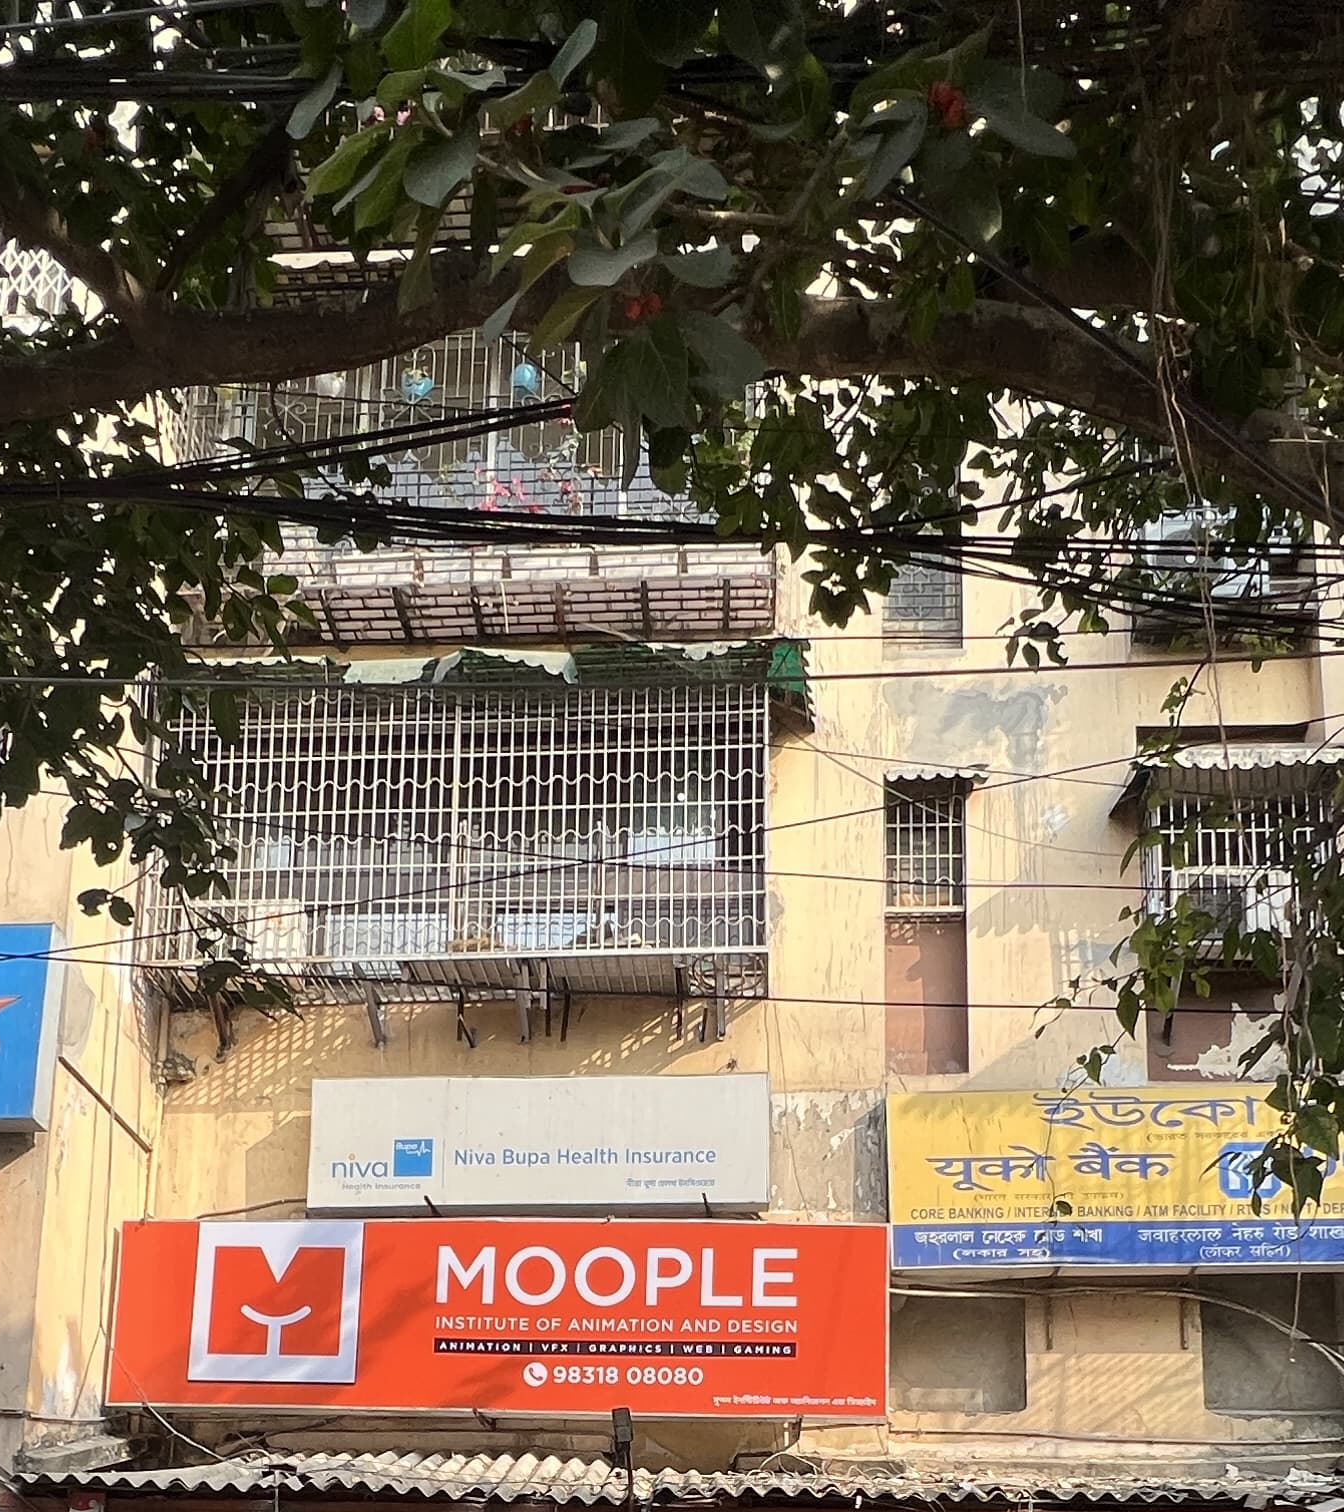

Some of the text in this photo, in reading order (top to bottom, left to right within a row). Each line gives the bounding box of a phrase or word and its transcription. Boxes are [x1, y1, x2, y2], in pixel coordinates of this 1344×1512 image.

[331, 1153, 388, 1178] niva
[454, 1148, 717, 1168] Niva Bupa Health Insurance
[926, 1142, 1176, 1191] यूको बैंक
[911, 1208, 945, 1219] CORE
[949, 1207, 1004, 1219] BANKING
[1077, 1205, 1133, 1217] BANKING
[1143, 1204, 1169, 1216] ATM
[1173, 1204, 1226, 1216] FACILITY
[1237, 1204, 1270, 1215] RTS
[1138, 1228, 1221, 1243] जवाहरलाल
[435, 1245, 799, 1308] MOOPLE
[435, 1316, 798, 1334] INSTITUTE OF ANIMATION AND DESIGN
[439, 1341, 522, 1352] ANIMATION
[541, 1343, 569, 1353] VFX
[588, 1344, 662, 1354] GRAPHICS
[682, 1345, 713, 1354] WEB
[733, 1345, 792, 1355] GAMING
[553, 1366, 704, 1385] 98318 08080
